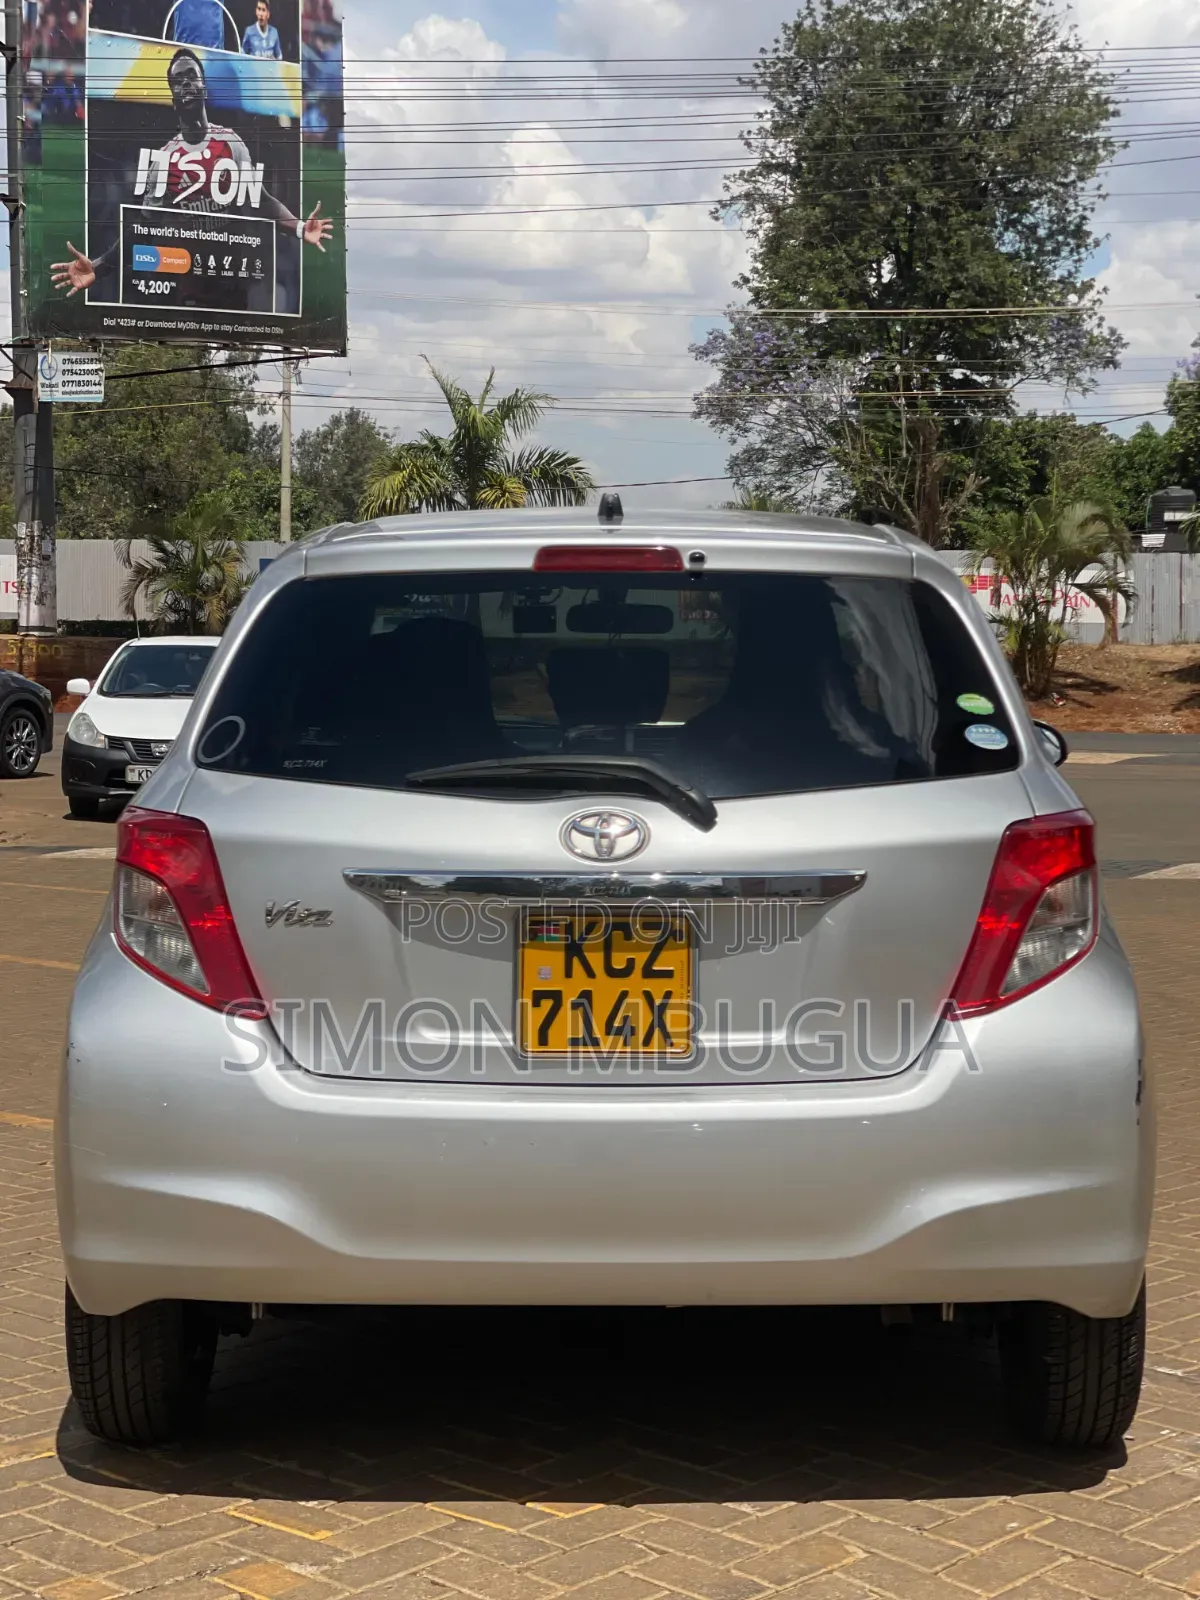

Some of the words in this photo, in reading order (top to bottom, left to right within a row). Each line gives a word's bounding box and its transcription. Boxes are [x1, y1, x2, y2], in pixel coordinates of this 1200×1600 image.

[134, 148, 211, 204] IT'S
[211, 158, 264, 208] ON
[133, 224, 149, 235] The
[150, 226, 179, 238] world's
[180, 228, 198, 239] best
[199, 229, 228, 242] football
[229, 233, 261, 248] package
[135, 254, 157, 263] DStv
[162, 256, 187, 265] Compact
[138, 279, 171, 295] 4,200
[103, 317, 116, 326] Dial
[145, 320, 177, 328] Download
[177, 321, 200, 331] MyDStv
[201, 322, 213, 332] App
[213, 323, 220, 331] to
[220, 324, 233, 333] stay
[234, 324, 265, 333] Connected
[61, 379, 102, 388] 0771830144
[265, 899, 334, 930] Vitz
[564, 921, 675, 979] KCZ
[531, 989, 675, 1048] 714X
